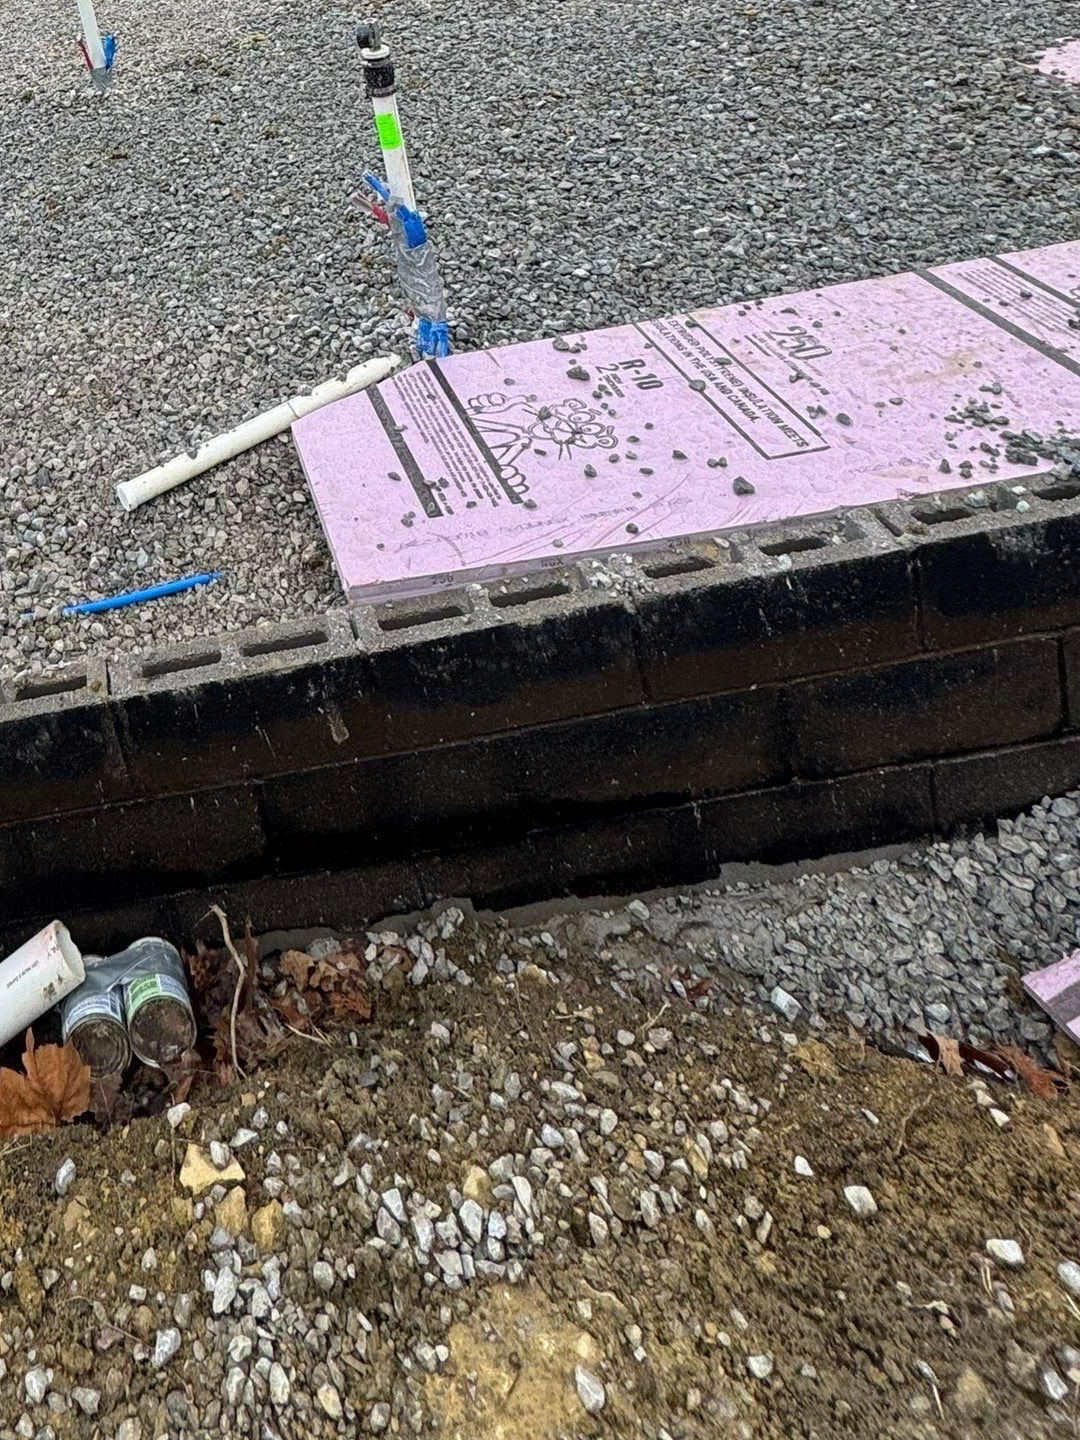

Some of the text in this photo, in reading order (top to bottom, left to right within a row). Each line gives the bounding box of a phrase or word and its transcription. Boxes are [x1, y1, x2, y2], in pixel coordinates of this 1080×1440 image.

[769, 326, 833, 360] 250
[594, 363, 620, 374] 2
[617, 359, 664, 390] R-10
[690, 357, 707, 369] THE
[713, 382, 733, 395] AND
[738, 387, 784, 424] INSULATION
[777, 424, 810, 447] MEETS
